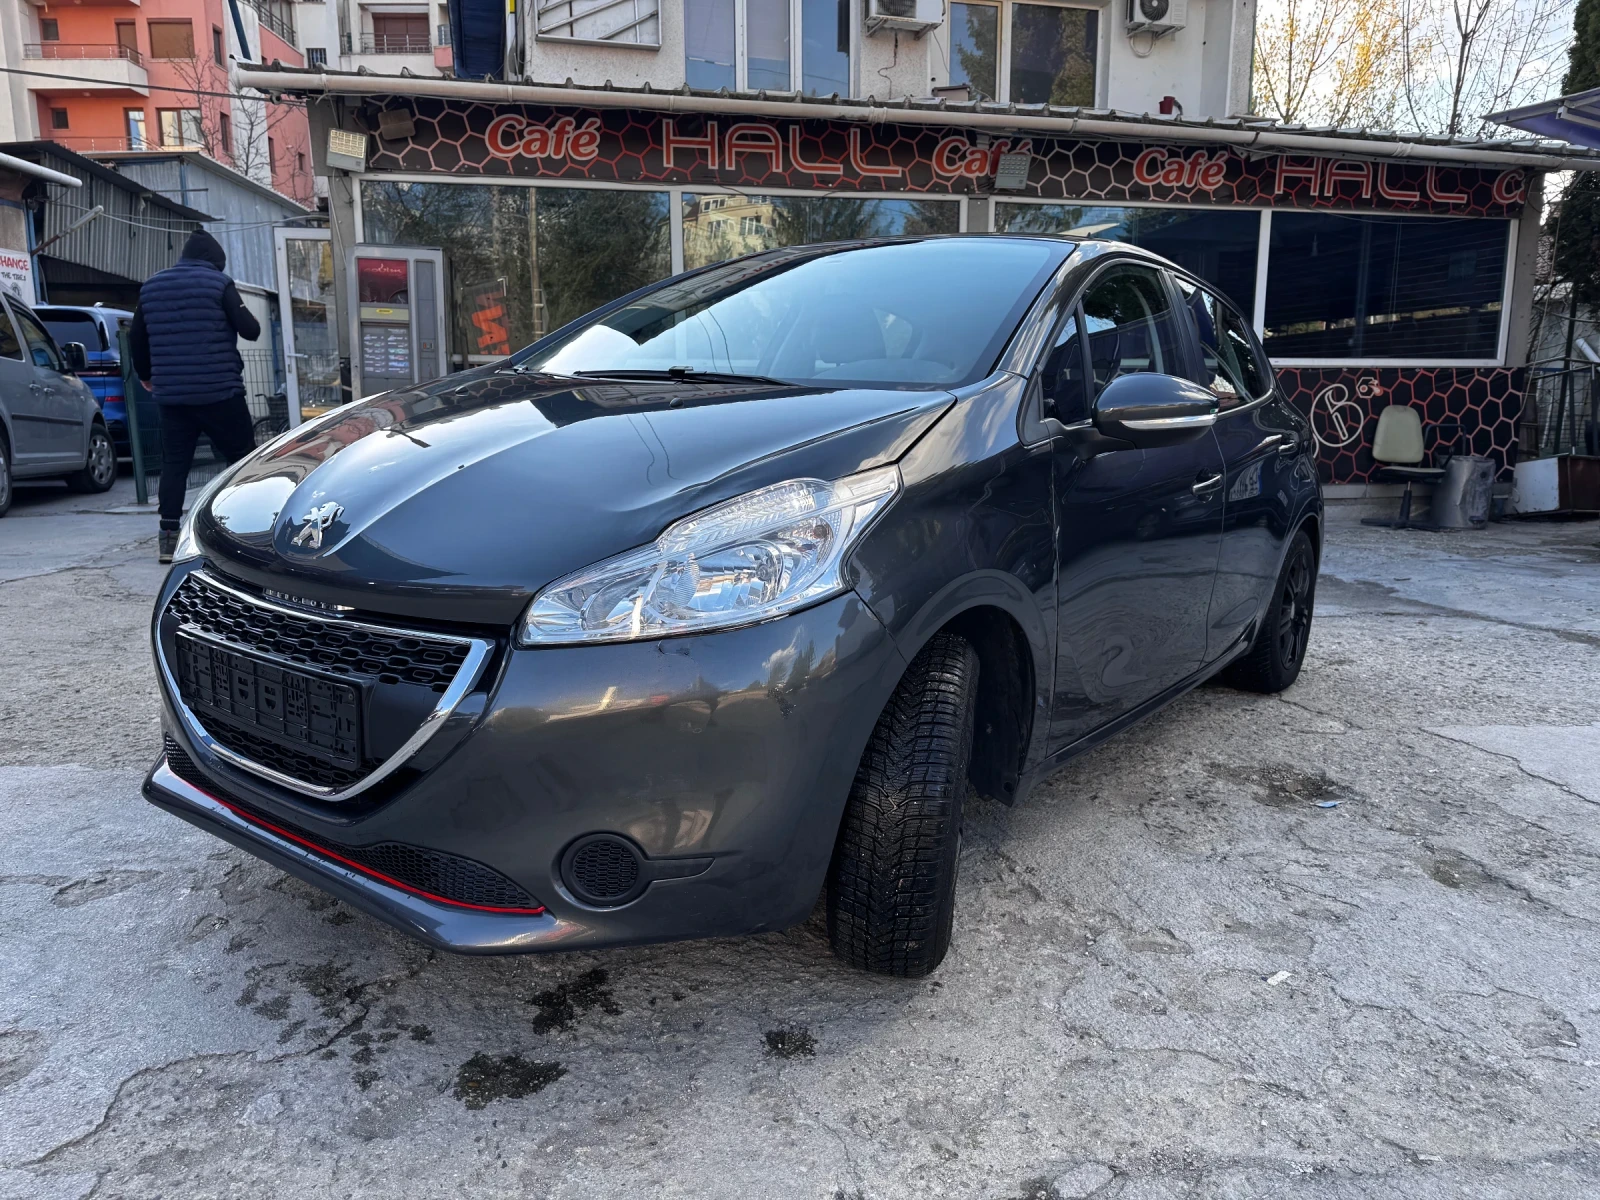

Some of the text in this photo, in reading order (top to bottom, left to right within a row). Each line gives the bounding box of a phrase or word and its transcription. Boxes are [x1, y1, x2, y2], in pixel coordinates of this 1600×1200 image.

[485, 114, 601, 161] Café
[662, 118, 902, 178] HALL
[1133, 147, 1229, 191] Café
[1274, 155, 1468, 204] HALL
[0, 255, 29, 271] HANGE
